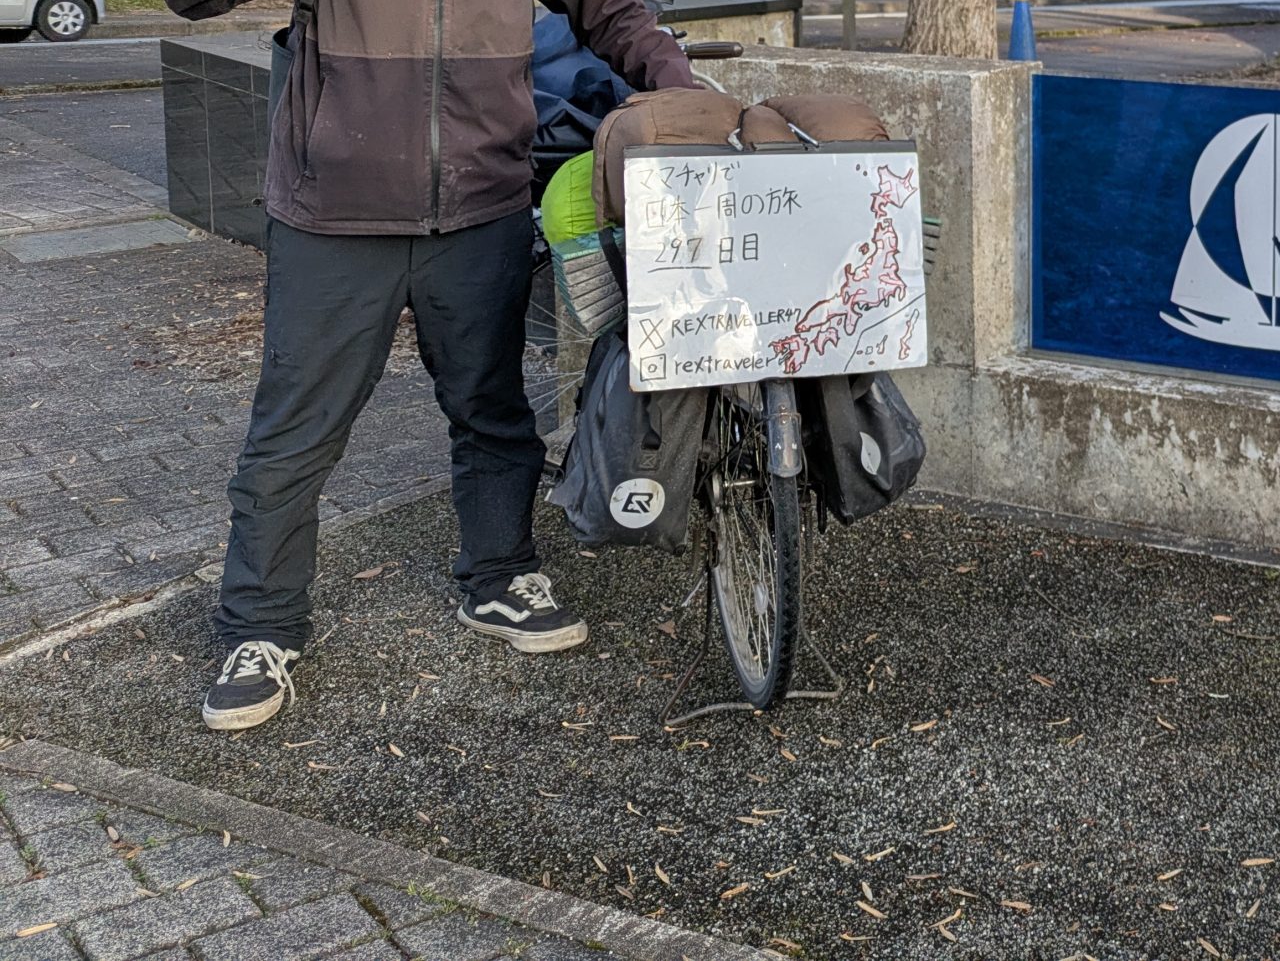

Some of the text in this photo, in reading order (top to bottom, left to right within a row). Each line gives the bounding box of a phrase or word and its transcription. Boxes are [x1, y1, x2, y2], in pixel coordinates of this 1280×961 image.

[638, 161, 741, 190] ママチャリで
[646, 186, 802, 228] 日本一周の旅
